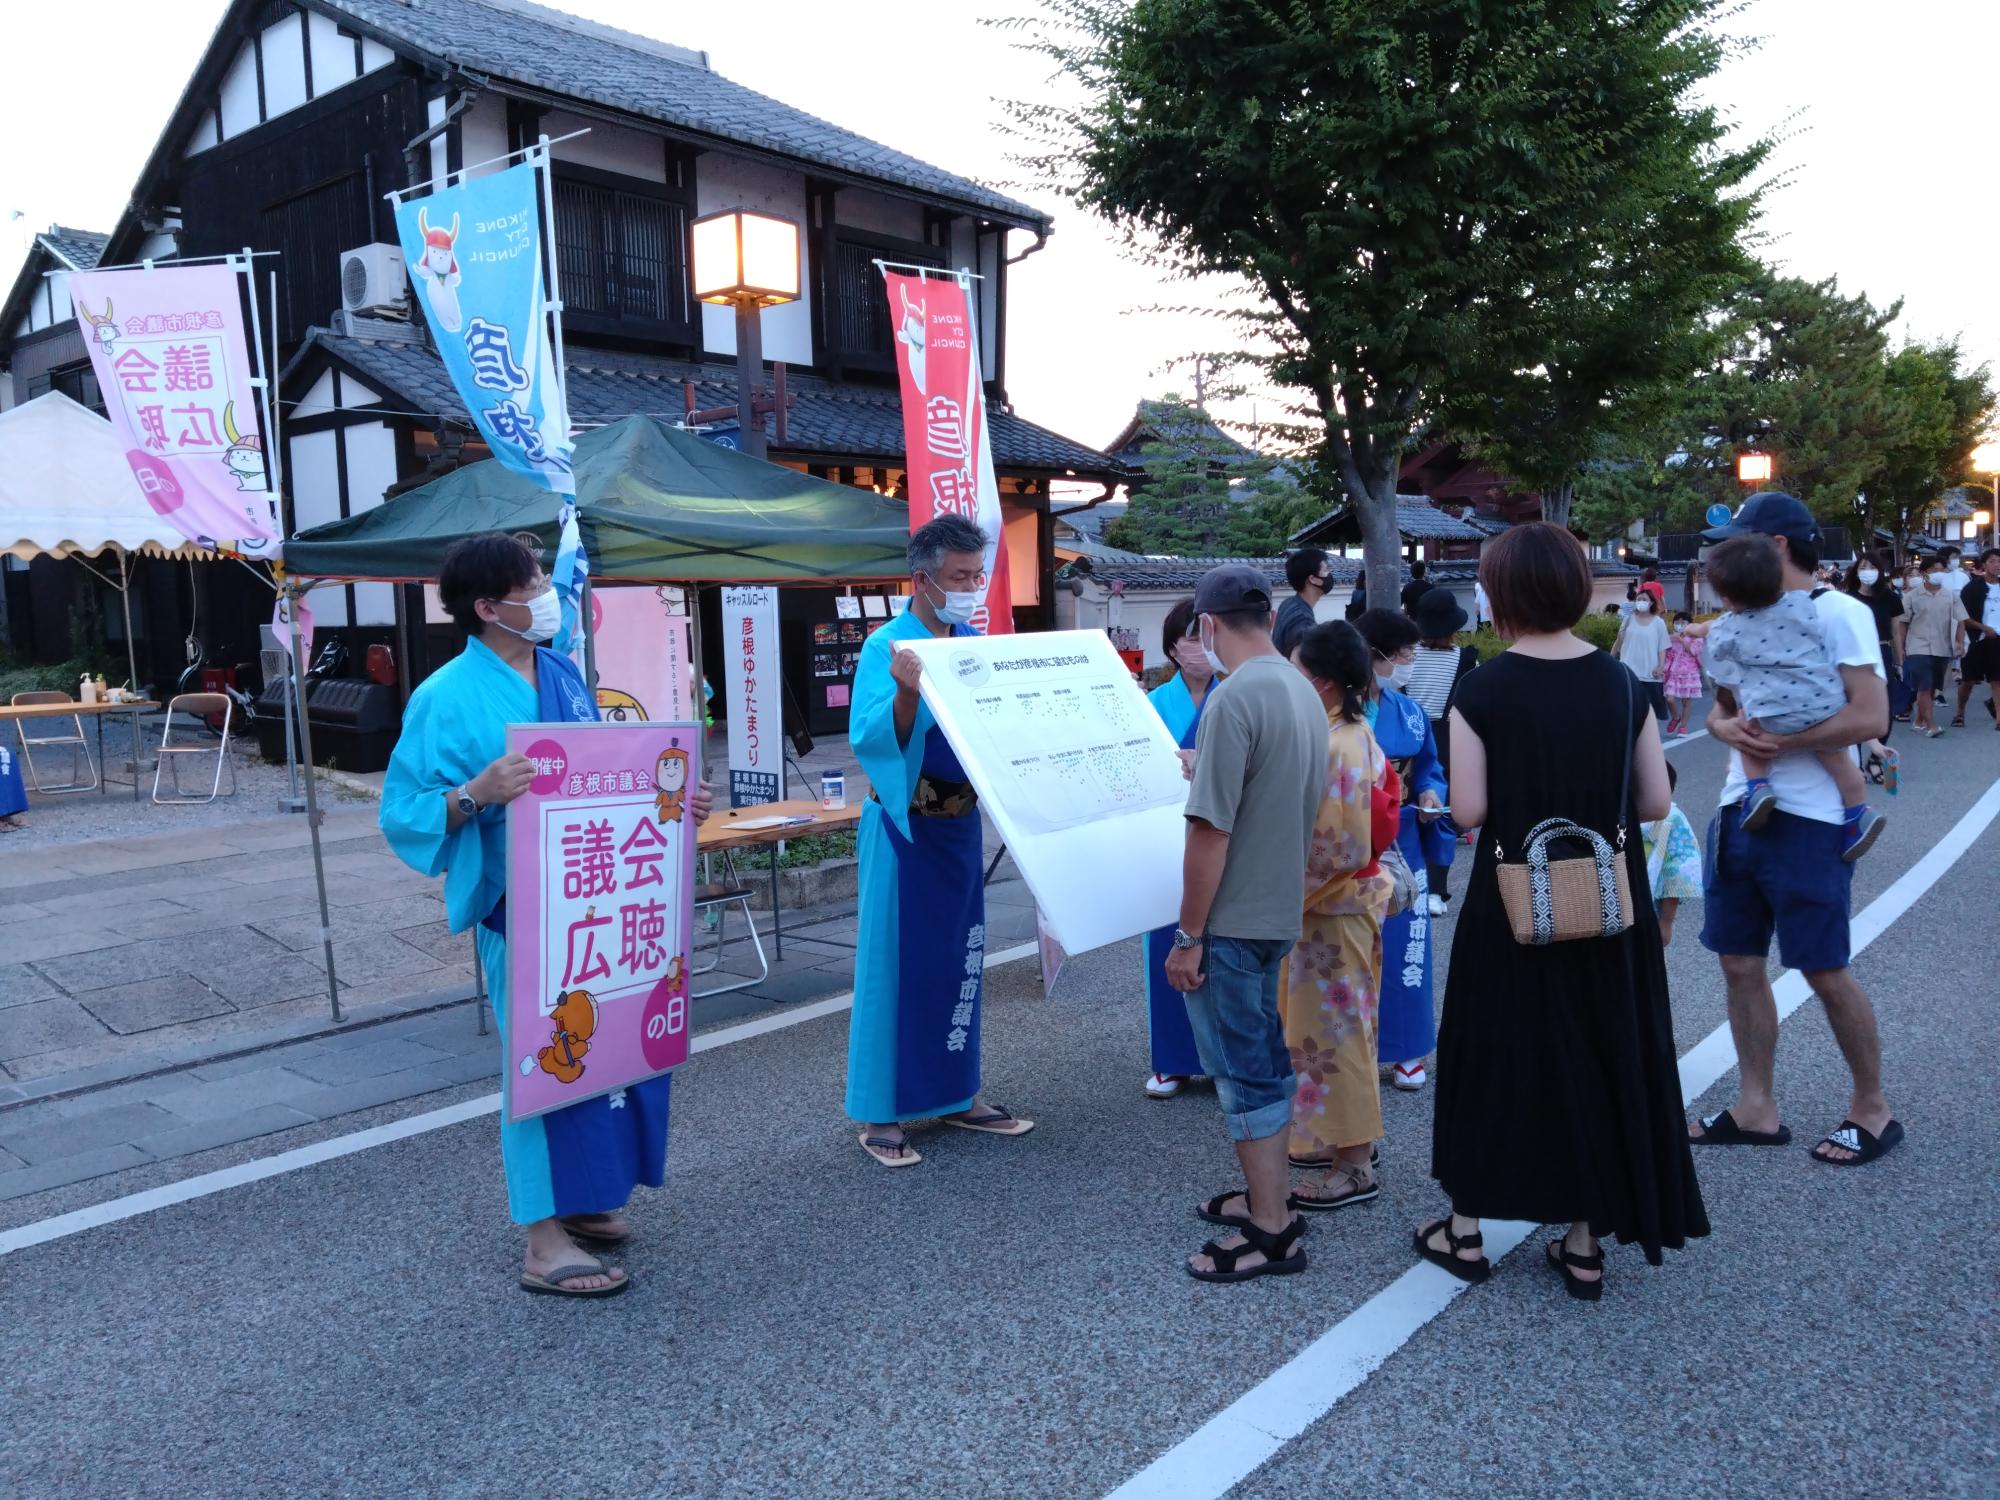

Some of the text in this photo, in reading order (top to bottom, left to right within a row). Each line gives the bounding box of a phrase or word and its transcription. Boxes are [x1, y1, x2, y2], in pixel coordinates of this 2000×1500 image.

[726, 592, 768, 607] キャッスルロード
[741, 617, 760, 767] 彦根ゆかたまつり
[569, 770, 650, 795] 彦根市議会
[561, 816, 668, 899] 議会
[561, 898, 667, 988] 広聴
[647, 997, 686, 1040] の日
[946, 923, 985, 1052] 彦根市議会
